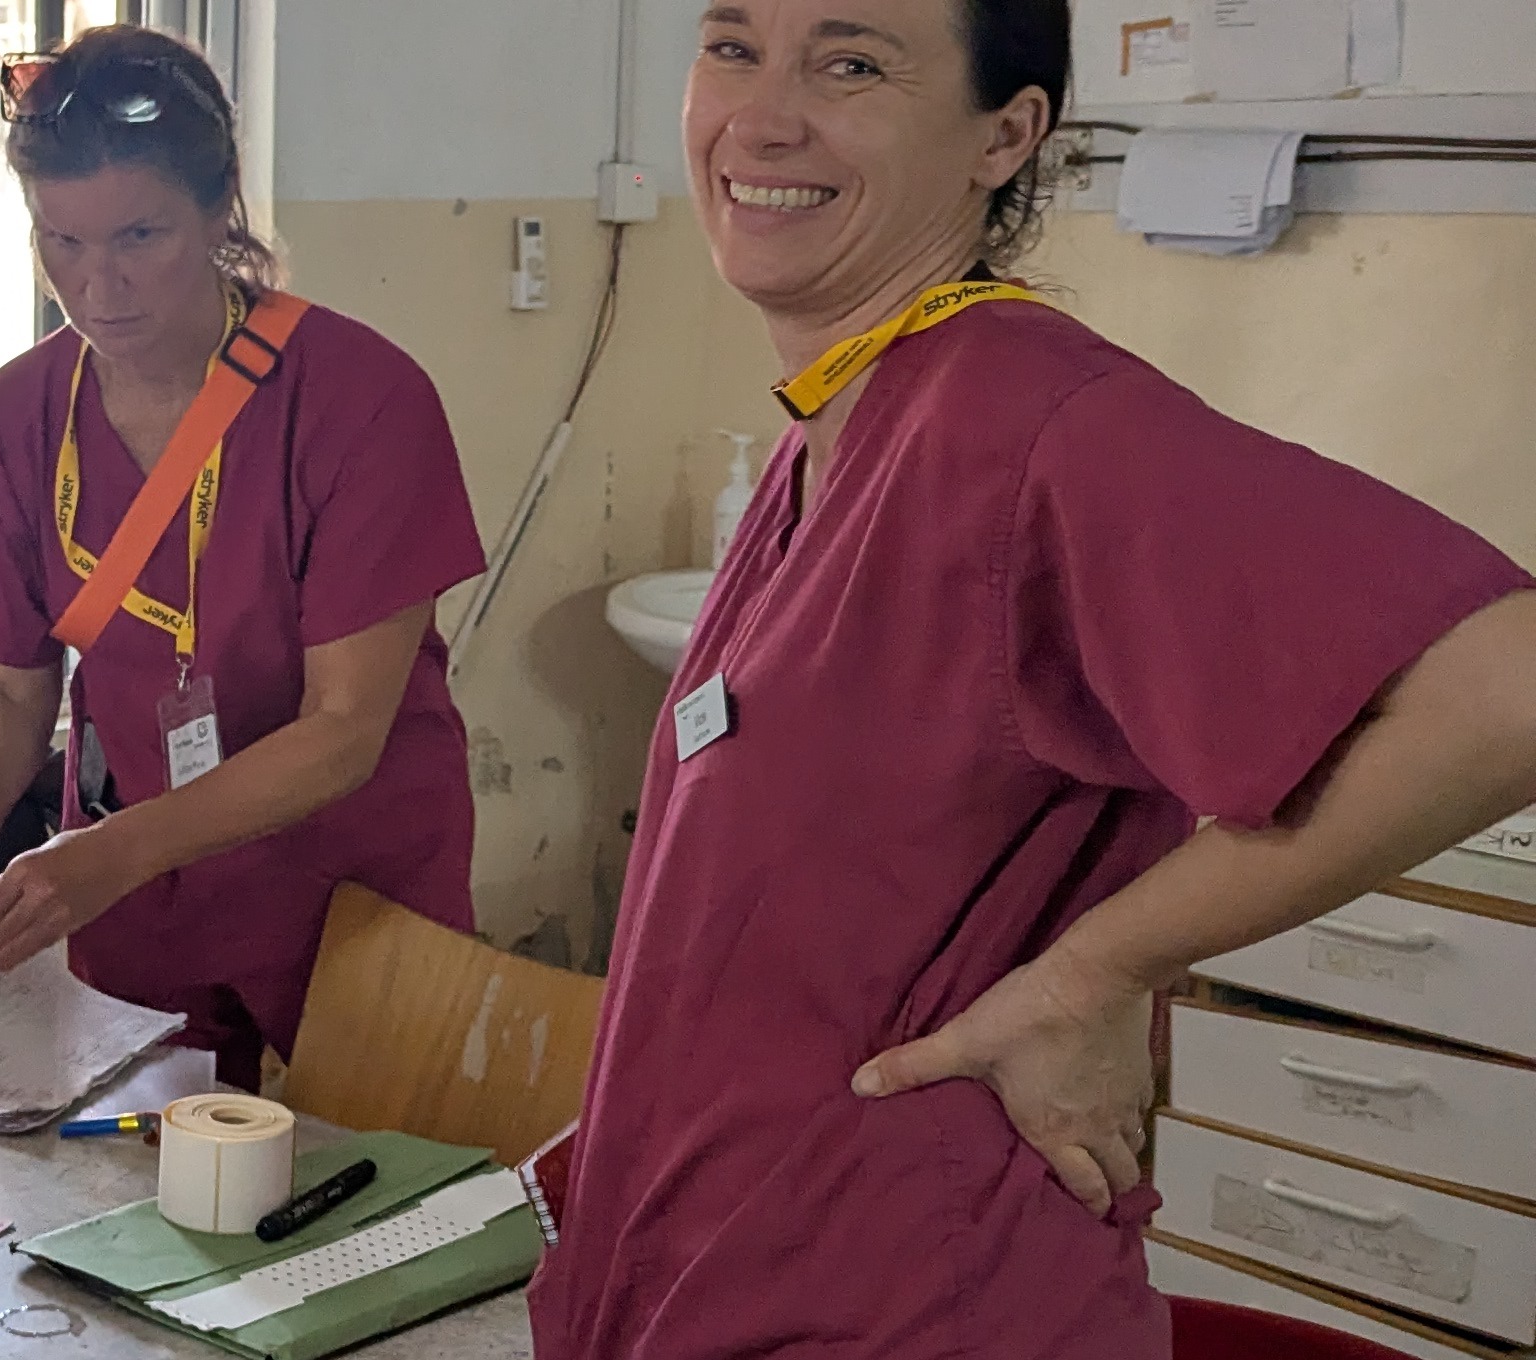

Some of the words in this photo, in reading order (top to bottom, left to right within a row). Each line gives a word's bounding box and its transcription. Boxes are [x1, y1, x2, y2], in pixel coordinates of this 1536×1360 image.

[923, 285, 1001, 317] stryker
[58, 474, 74, 534] stryker
[196, 468, 215, 529] stryker
[142, 605, 183, 630] ryker
